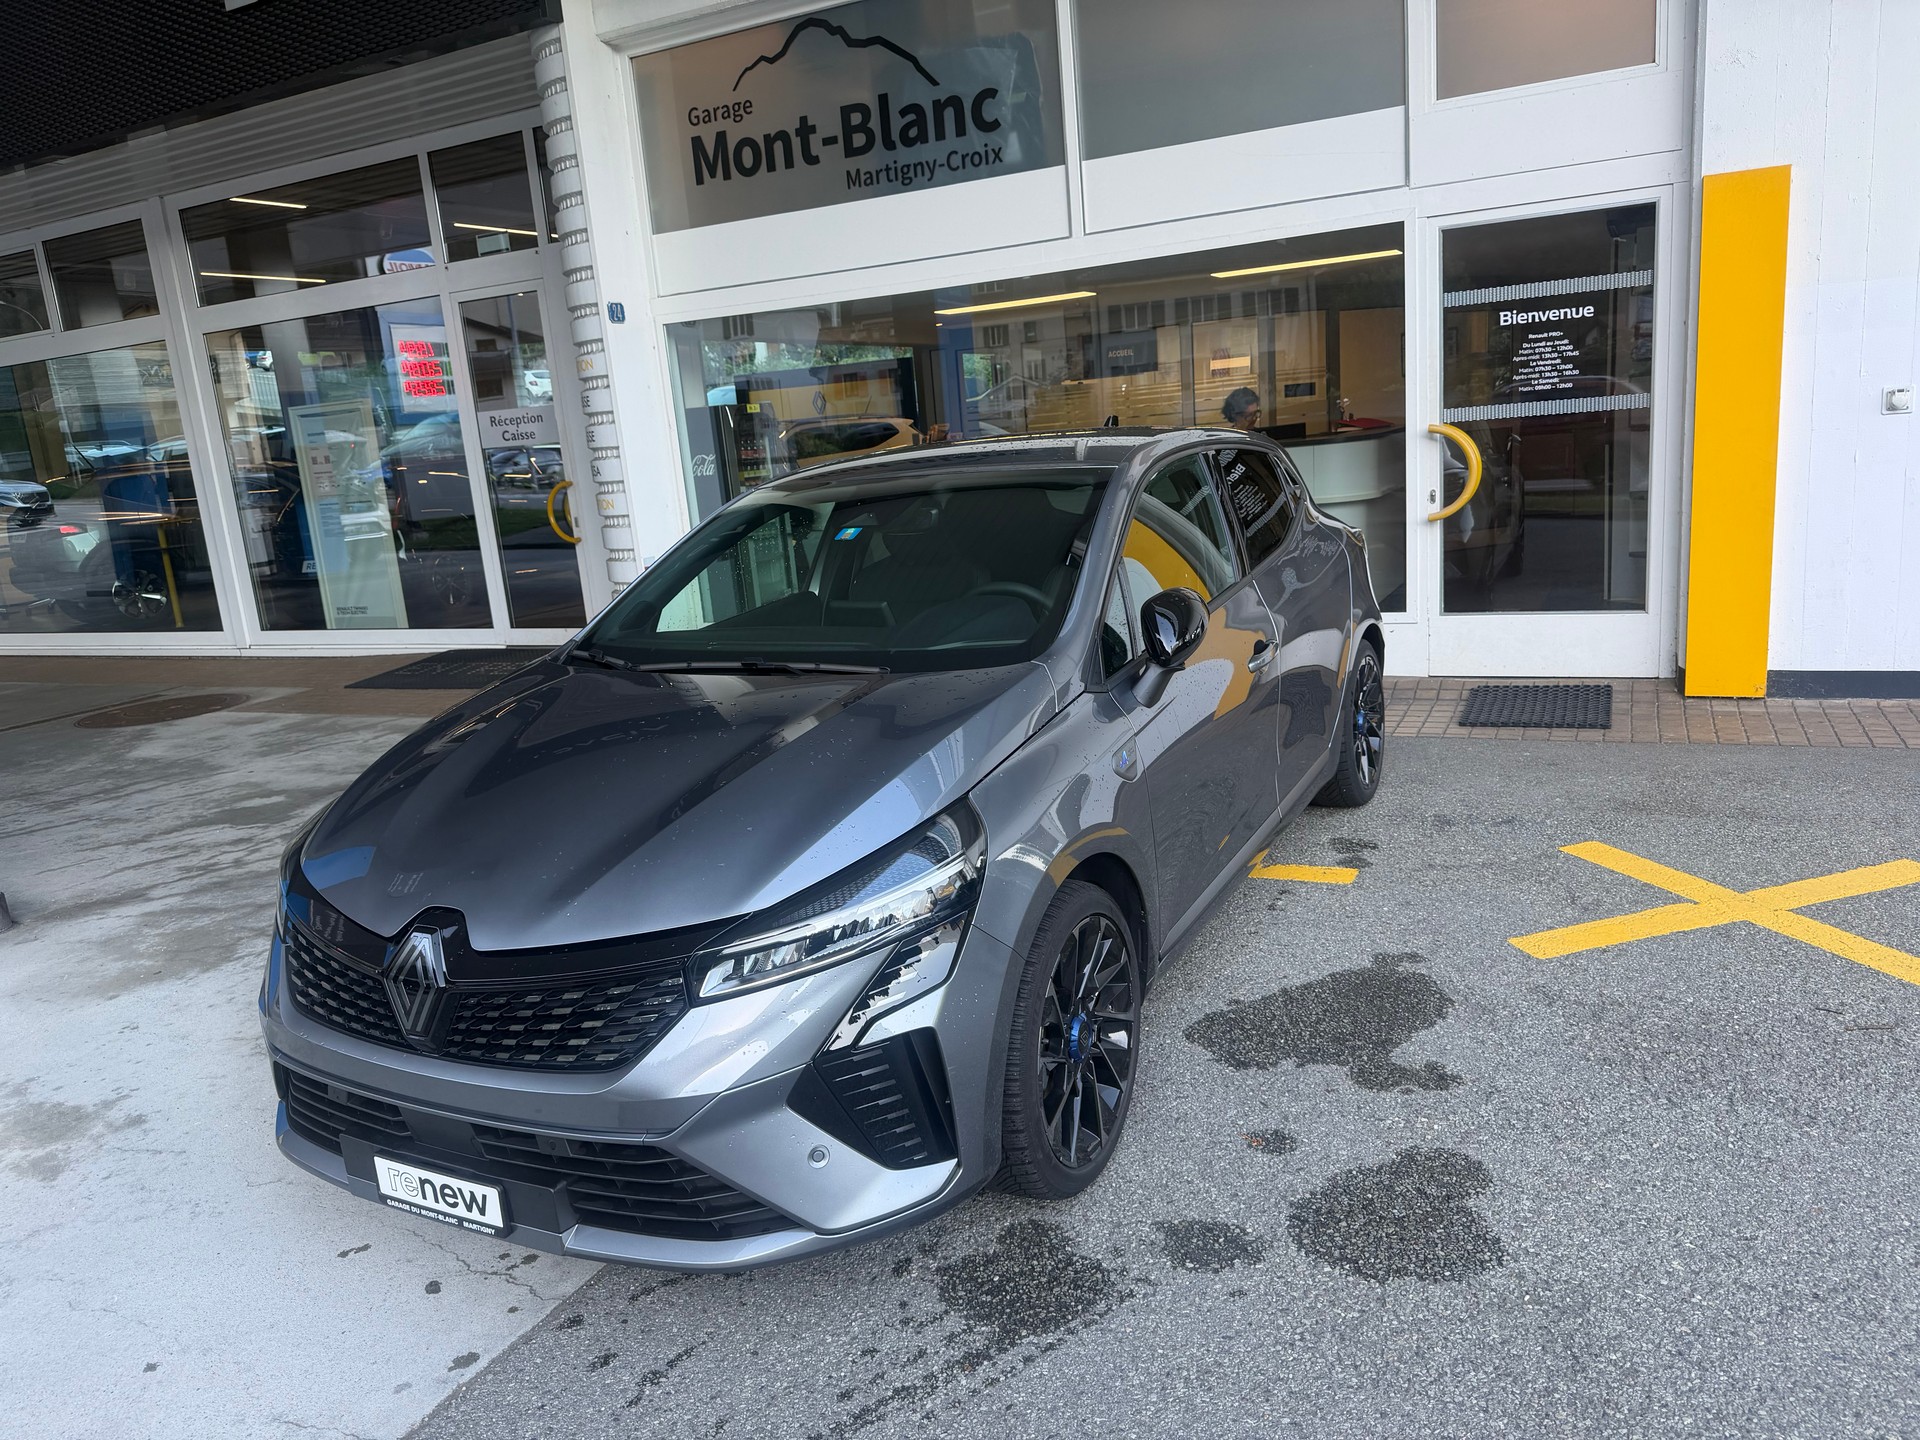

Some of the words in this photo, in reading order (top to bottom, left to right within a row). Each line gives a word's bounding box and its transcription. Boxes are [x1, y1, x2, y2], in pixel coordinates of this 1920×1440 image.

[688, 97, 754, 126] Garage
[690, 87, 1002, 186] Mont-Blanc
[845, 143, 1004, 189] Martigny-Croix
[611, 305, 624, 322] 24
[1499, 305, 1594, 326] Bienvenue
[1108, 349, 1134, 358] ACCUEIL
[490, 412, 543, 428] Réception
[501, 429, 537, 442] Caisse
[387, 1167, 488, 1217] renew
[386, 1199, 411, 1212] GARAGE
[411, 1206, 420, 1214] DU
[420, 1209, 459, 1225] MONT-BLANC
[463, 1221, 496, 1235] MARTIGNY
